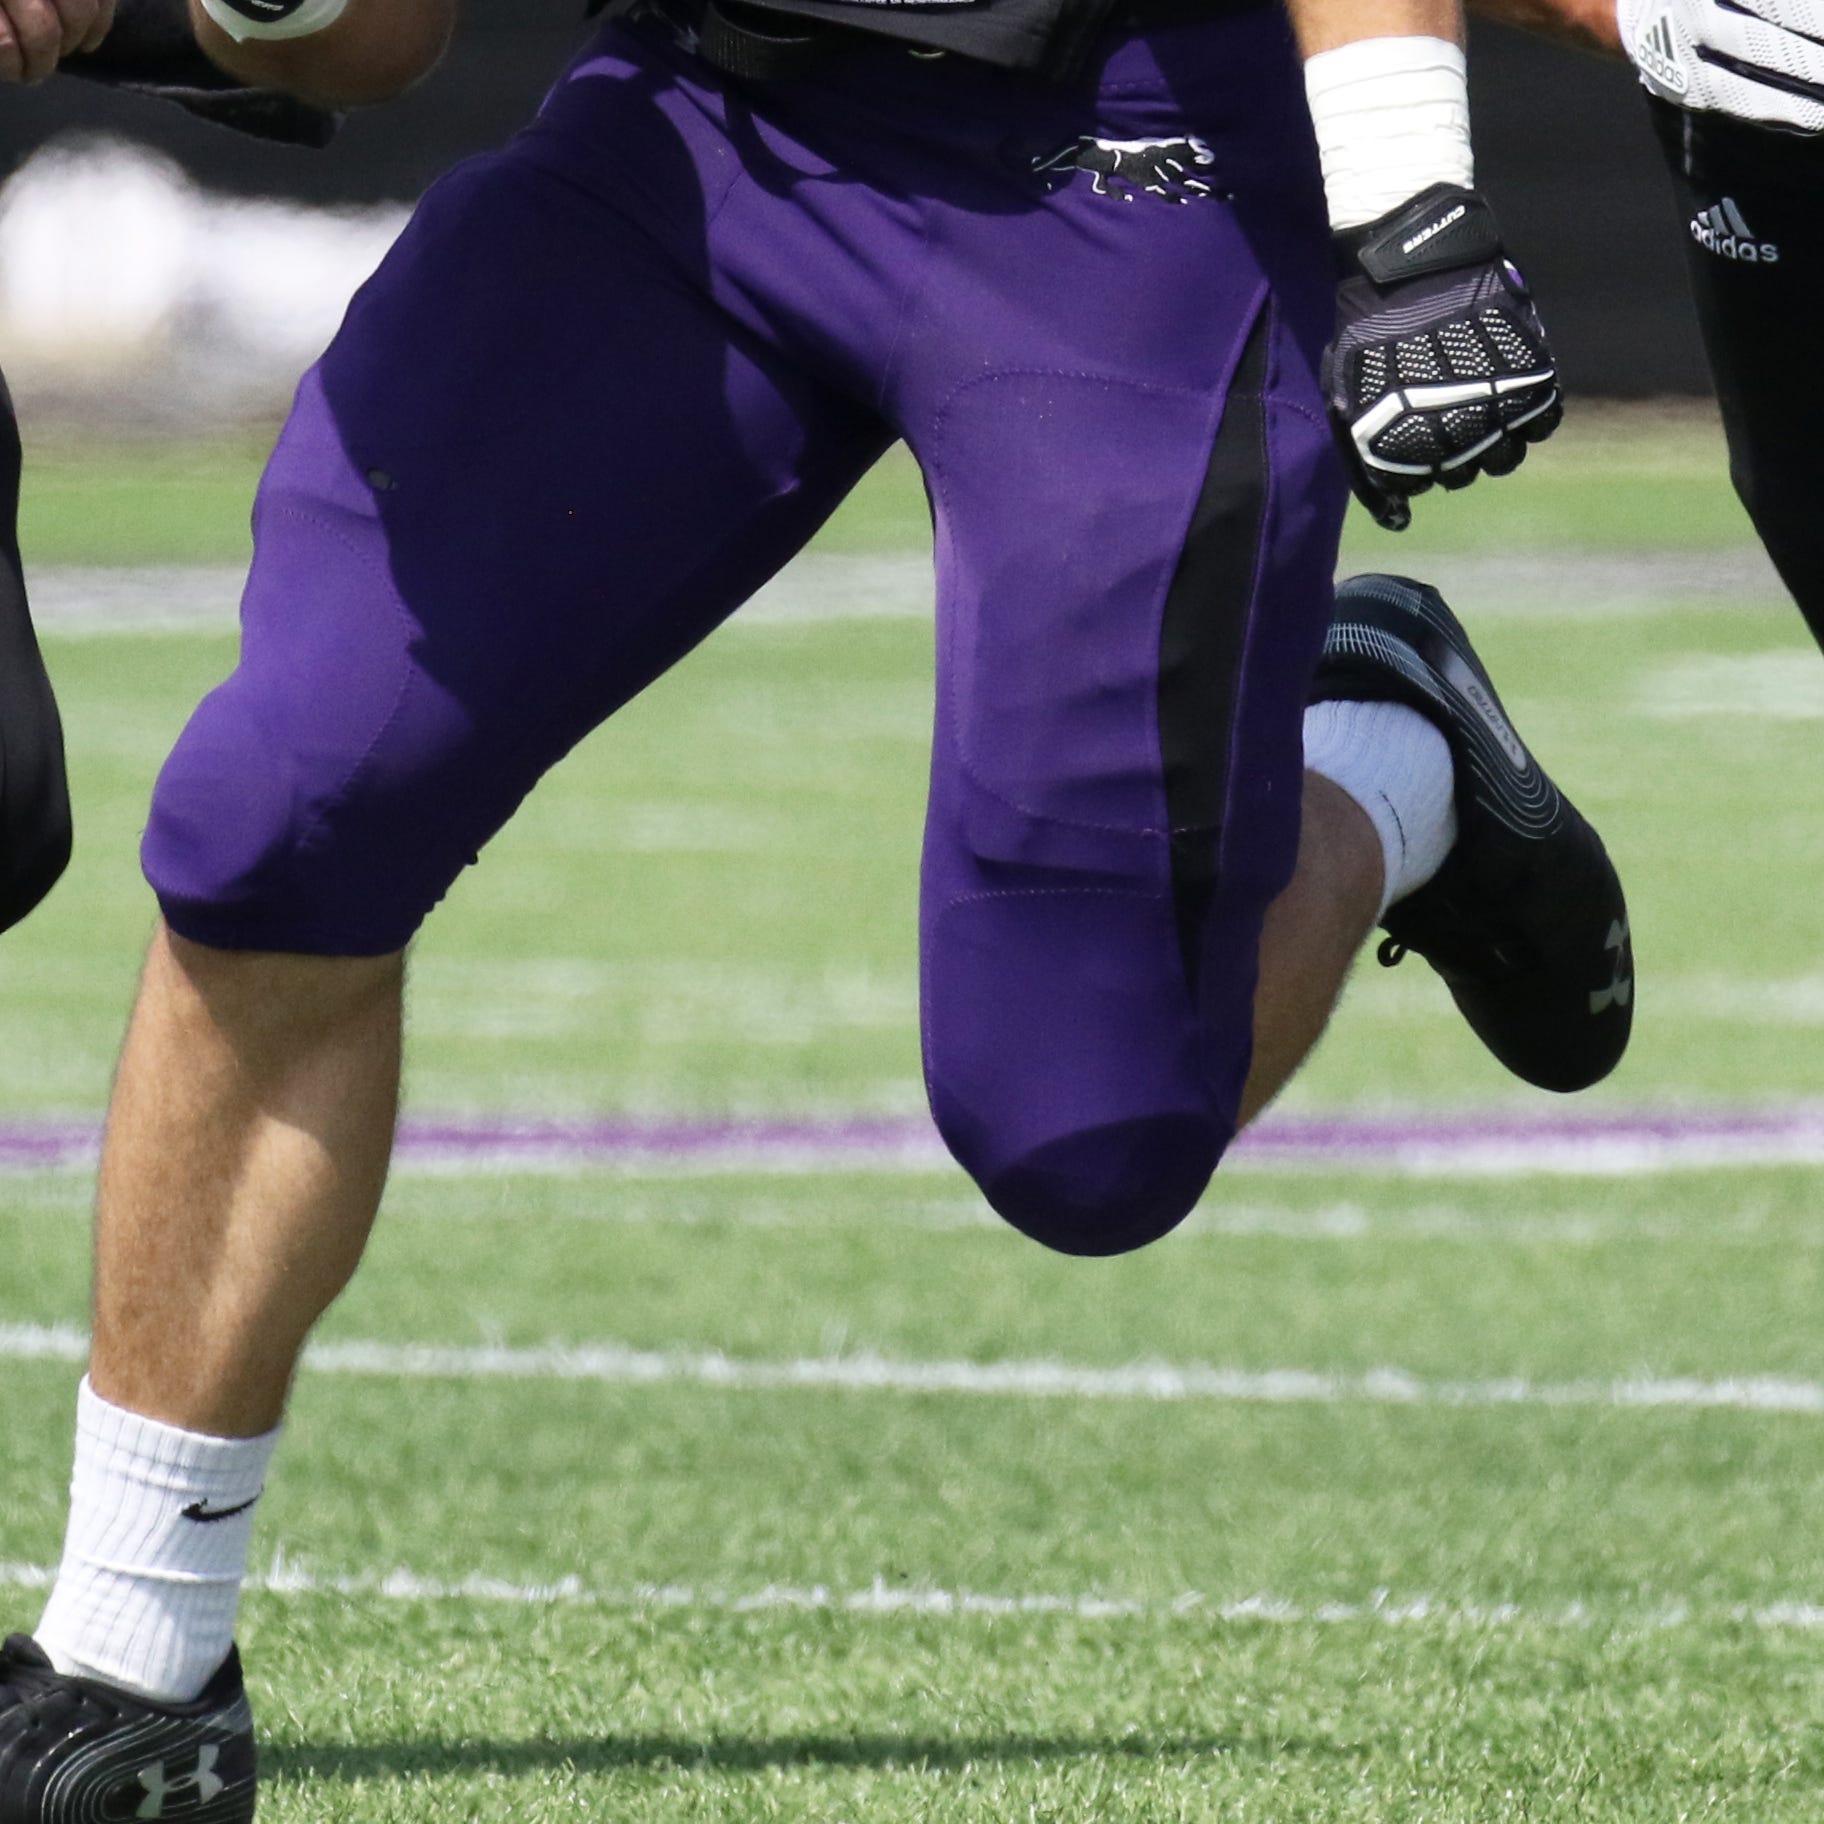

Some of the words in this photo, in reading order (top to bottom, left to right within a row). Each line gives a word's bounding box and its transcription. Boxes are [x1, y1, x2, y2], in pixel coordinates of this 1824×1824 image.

[1638, 43, 1684, 89] adidas
[1402, 204, 1466, 254] CUTTERS
[1690, 219, 1779, 263] adidas
